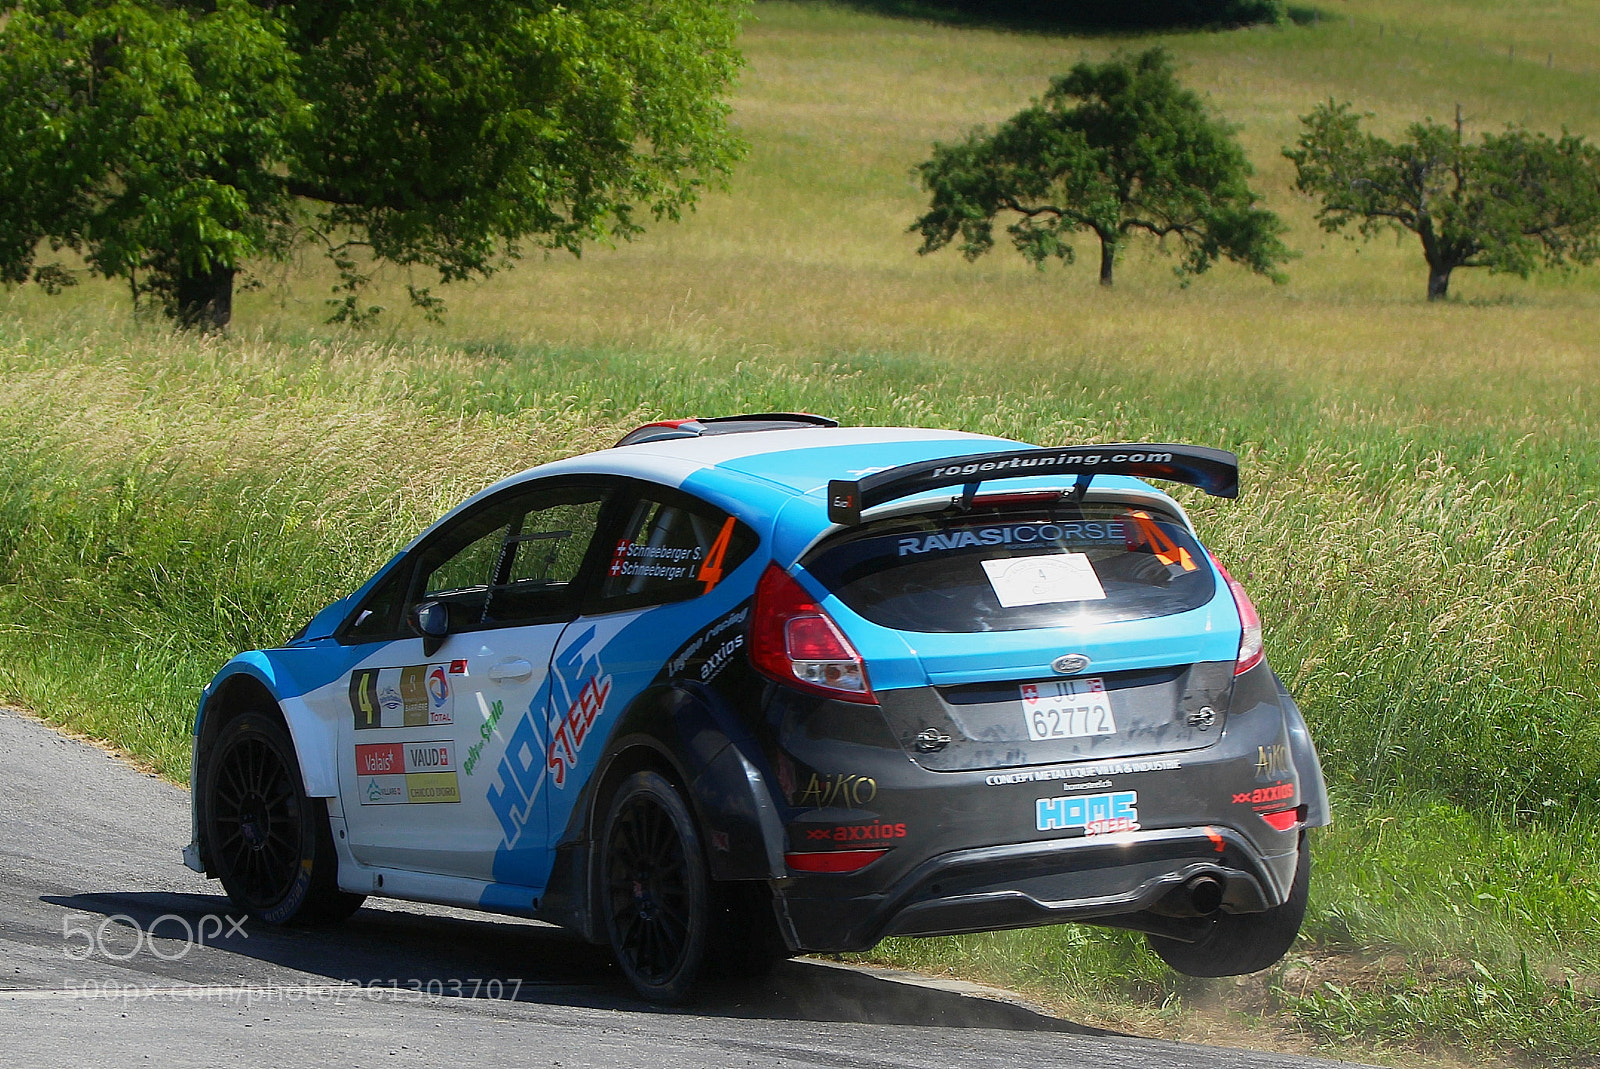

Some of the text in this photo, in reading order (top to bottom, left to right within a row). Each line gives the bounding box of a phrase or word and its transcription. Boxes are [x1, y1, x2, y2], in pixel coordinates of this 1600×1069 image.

[933, 451, 1173, 478] rogertuning.com
[626, 543, 702, 562] Schneeberger S.
[1132, 511, 1198, 572] 4
[698, 516, 738, 595] 4
[621, 561, 686, 580] Schneeberger
[701, 635, 743, 679] axxios
[358, 673, 373, 724] 4
[1054, 681, 1076, 702] JU
[548, 674, 612, 790] STEEL
[1033, 705, 1110, 738] 62772
[365, 752, 391, 771] Valais
[411, 748, 439, 767] VAUD
[986, 771, 1034, 786] CONCEPT
[410, 787, 435, 798] CHICCO
[1252, 780, 1295, 804] axxios
[1035, 790, 1138, 832] HOME
[833, 820, 907, 841] axxios
[1084, 817, 1141, 837] STEEL
